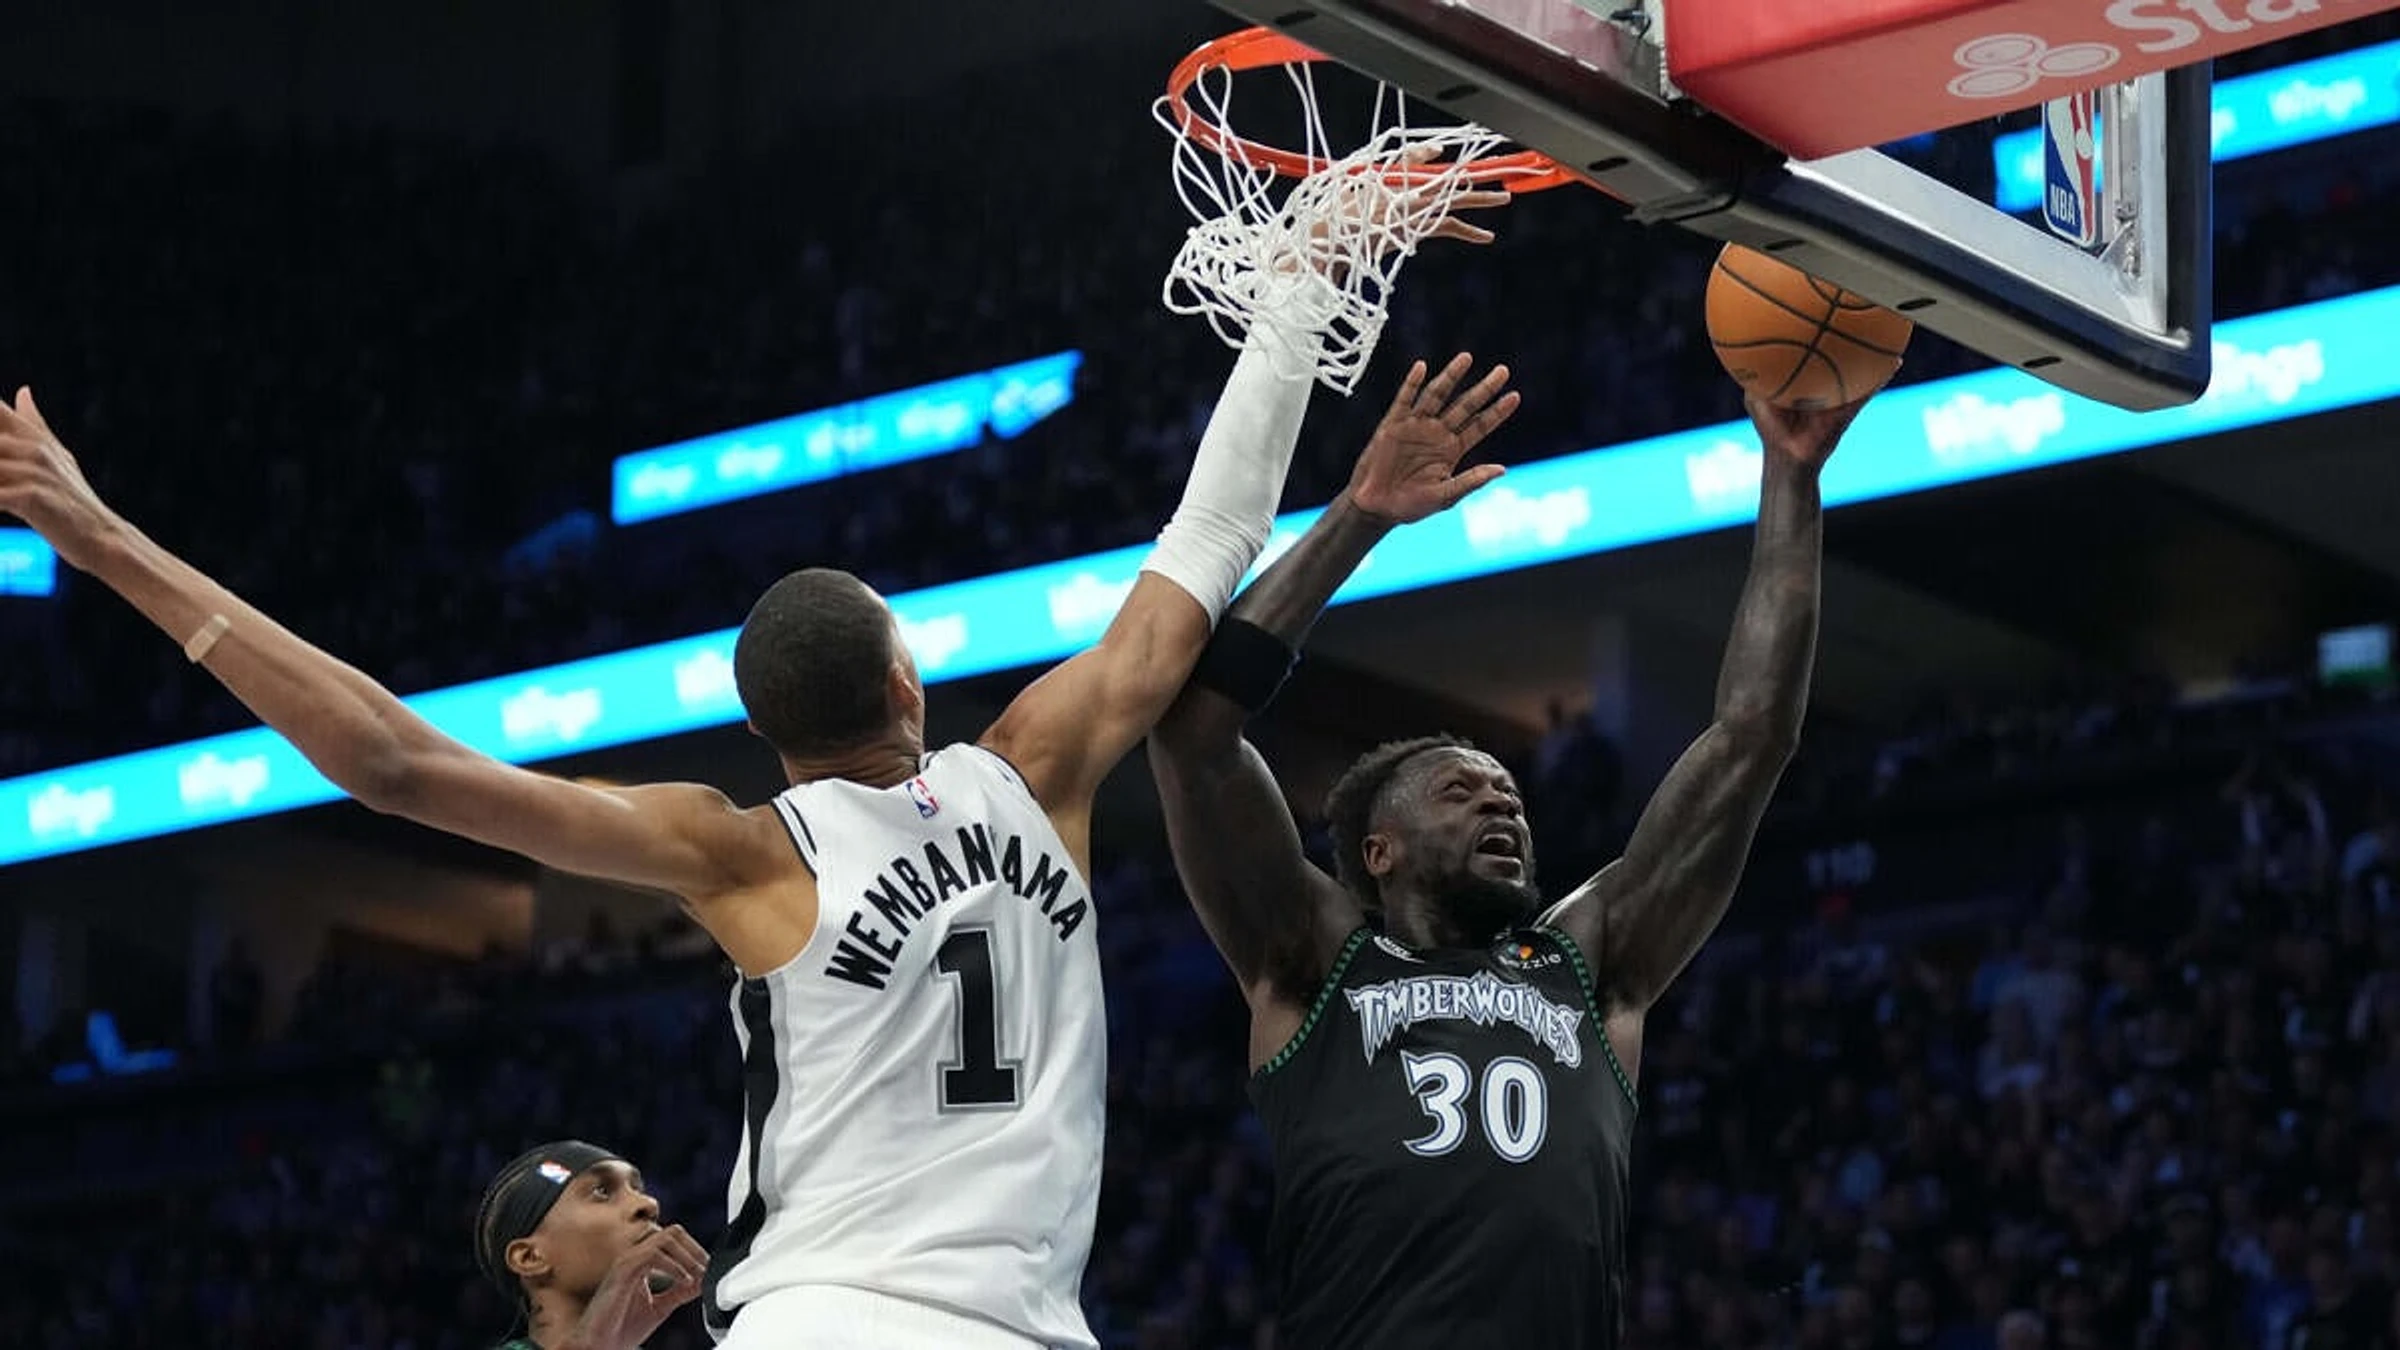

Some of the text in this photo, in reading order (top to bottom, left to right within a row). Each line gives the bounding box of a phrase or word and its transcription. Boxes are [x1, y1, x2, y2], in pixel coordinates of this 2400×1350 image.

[2050, 184, 2076, 225] NBA
[824, 822, 1088, 991] WEMBANAMA
[933, 921, 1024, 1114] 1
[1344, 970, 1585, 1068] TIMBERWOLVES
[1401, 1050, 1548, 1163] 30
